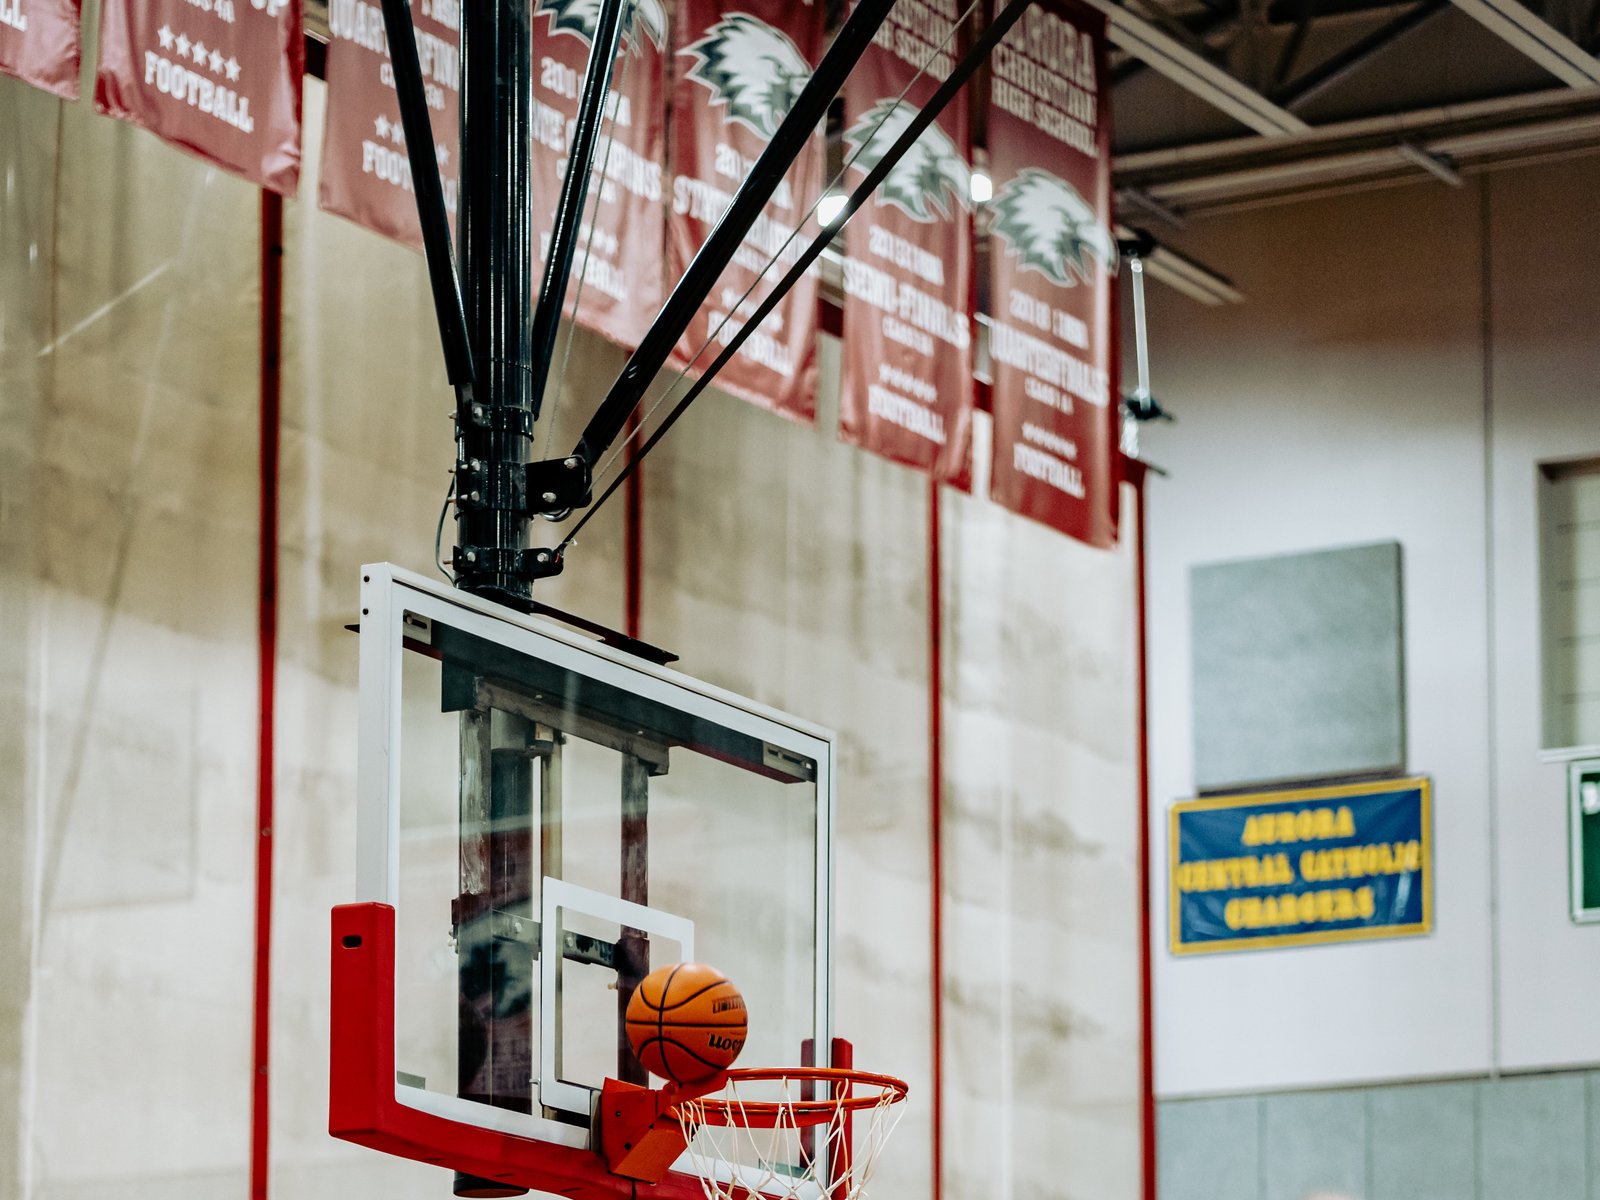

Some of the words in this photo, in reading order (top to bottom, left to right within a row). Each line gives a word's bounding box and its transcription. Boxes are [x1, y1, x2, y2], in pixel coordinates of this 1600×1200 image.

[144, 50, 255, 134] FOOTBALL
[1240, 805, 1357, 847] AURORA
[1178, 852, 1295, 893] CENTRAL
[1300, 839, 1422, 883] CATHOLIC
[1223, 885, 1376, 931] CHARGERS
